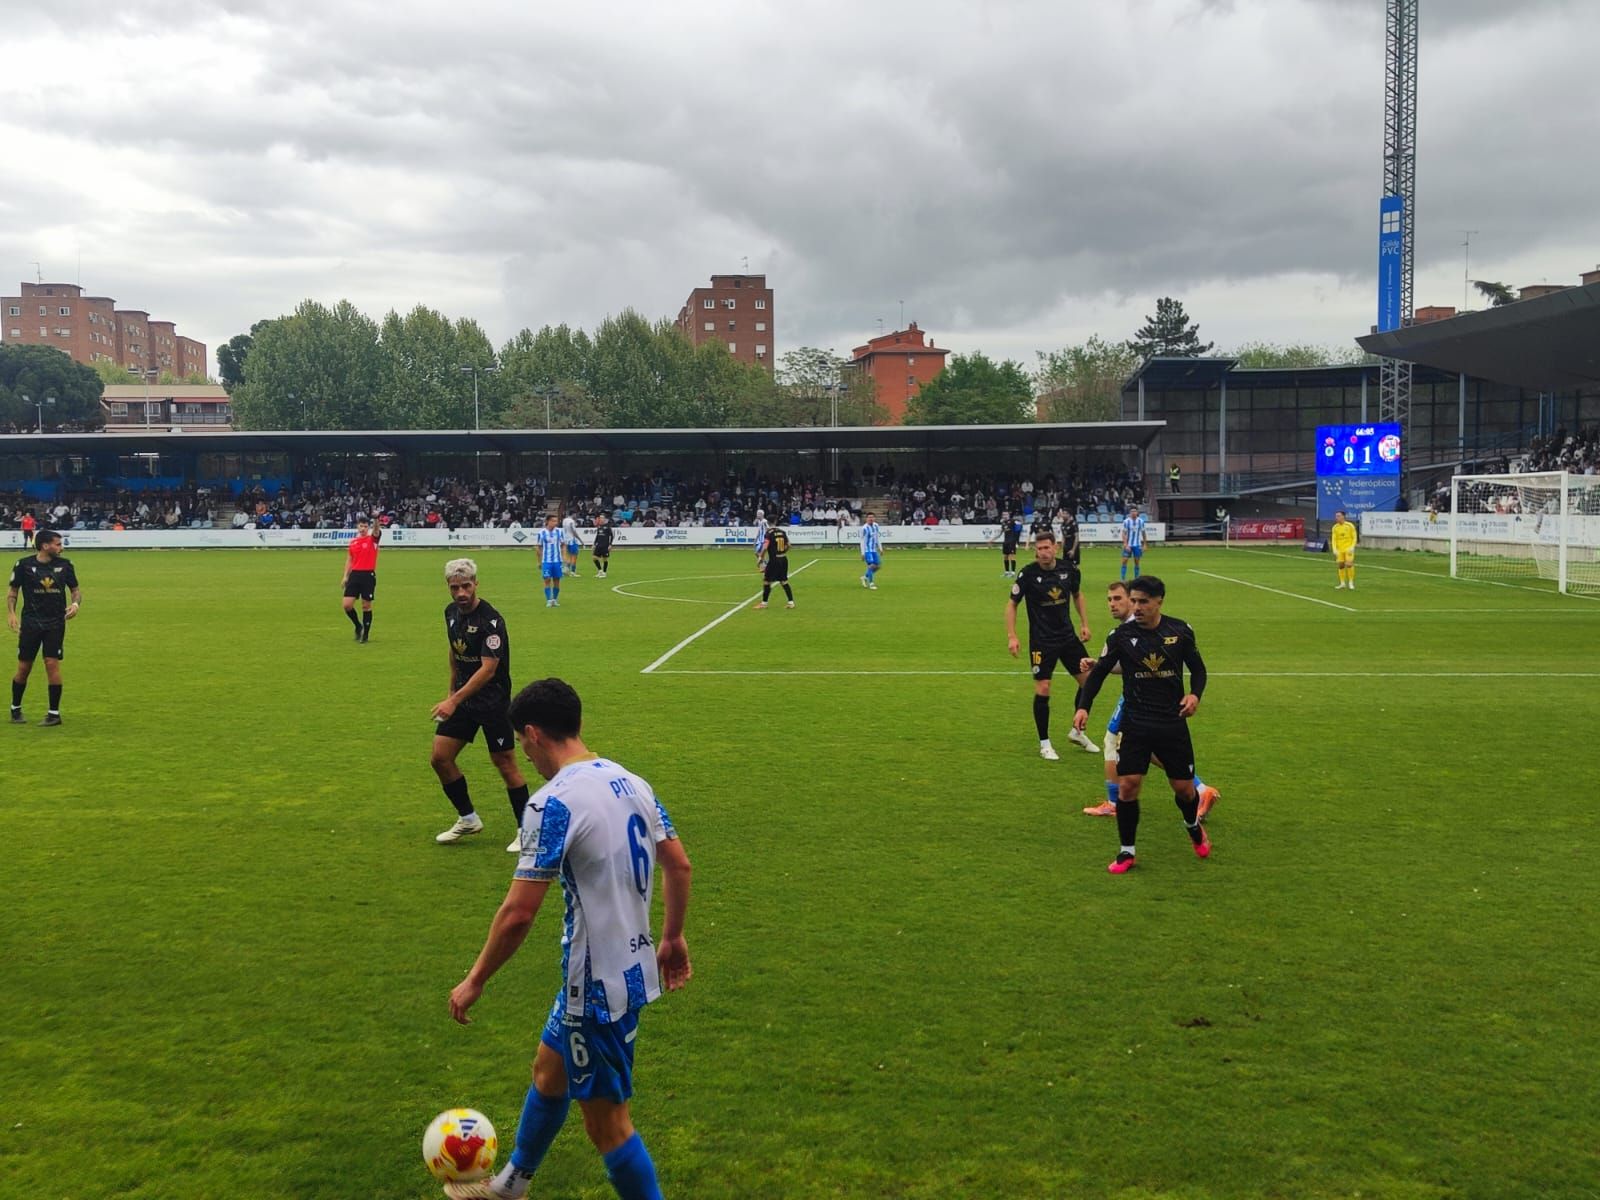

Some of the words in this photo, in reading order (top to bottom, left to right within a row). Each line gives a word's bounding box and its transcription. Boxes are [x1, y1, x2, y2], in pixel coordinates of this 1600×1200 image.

[1382, 247, 1400, 256] PVC
[1344, 446, 1354, 464] 0
[1363, 446, 1371, 463] 1
[725, 528, 747, 537] Pujol
[1031, 651, 1042, 665] 16
[627, 813, 650, 897] 6
[569, 1031, 589, 1068] 6
